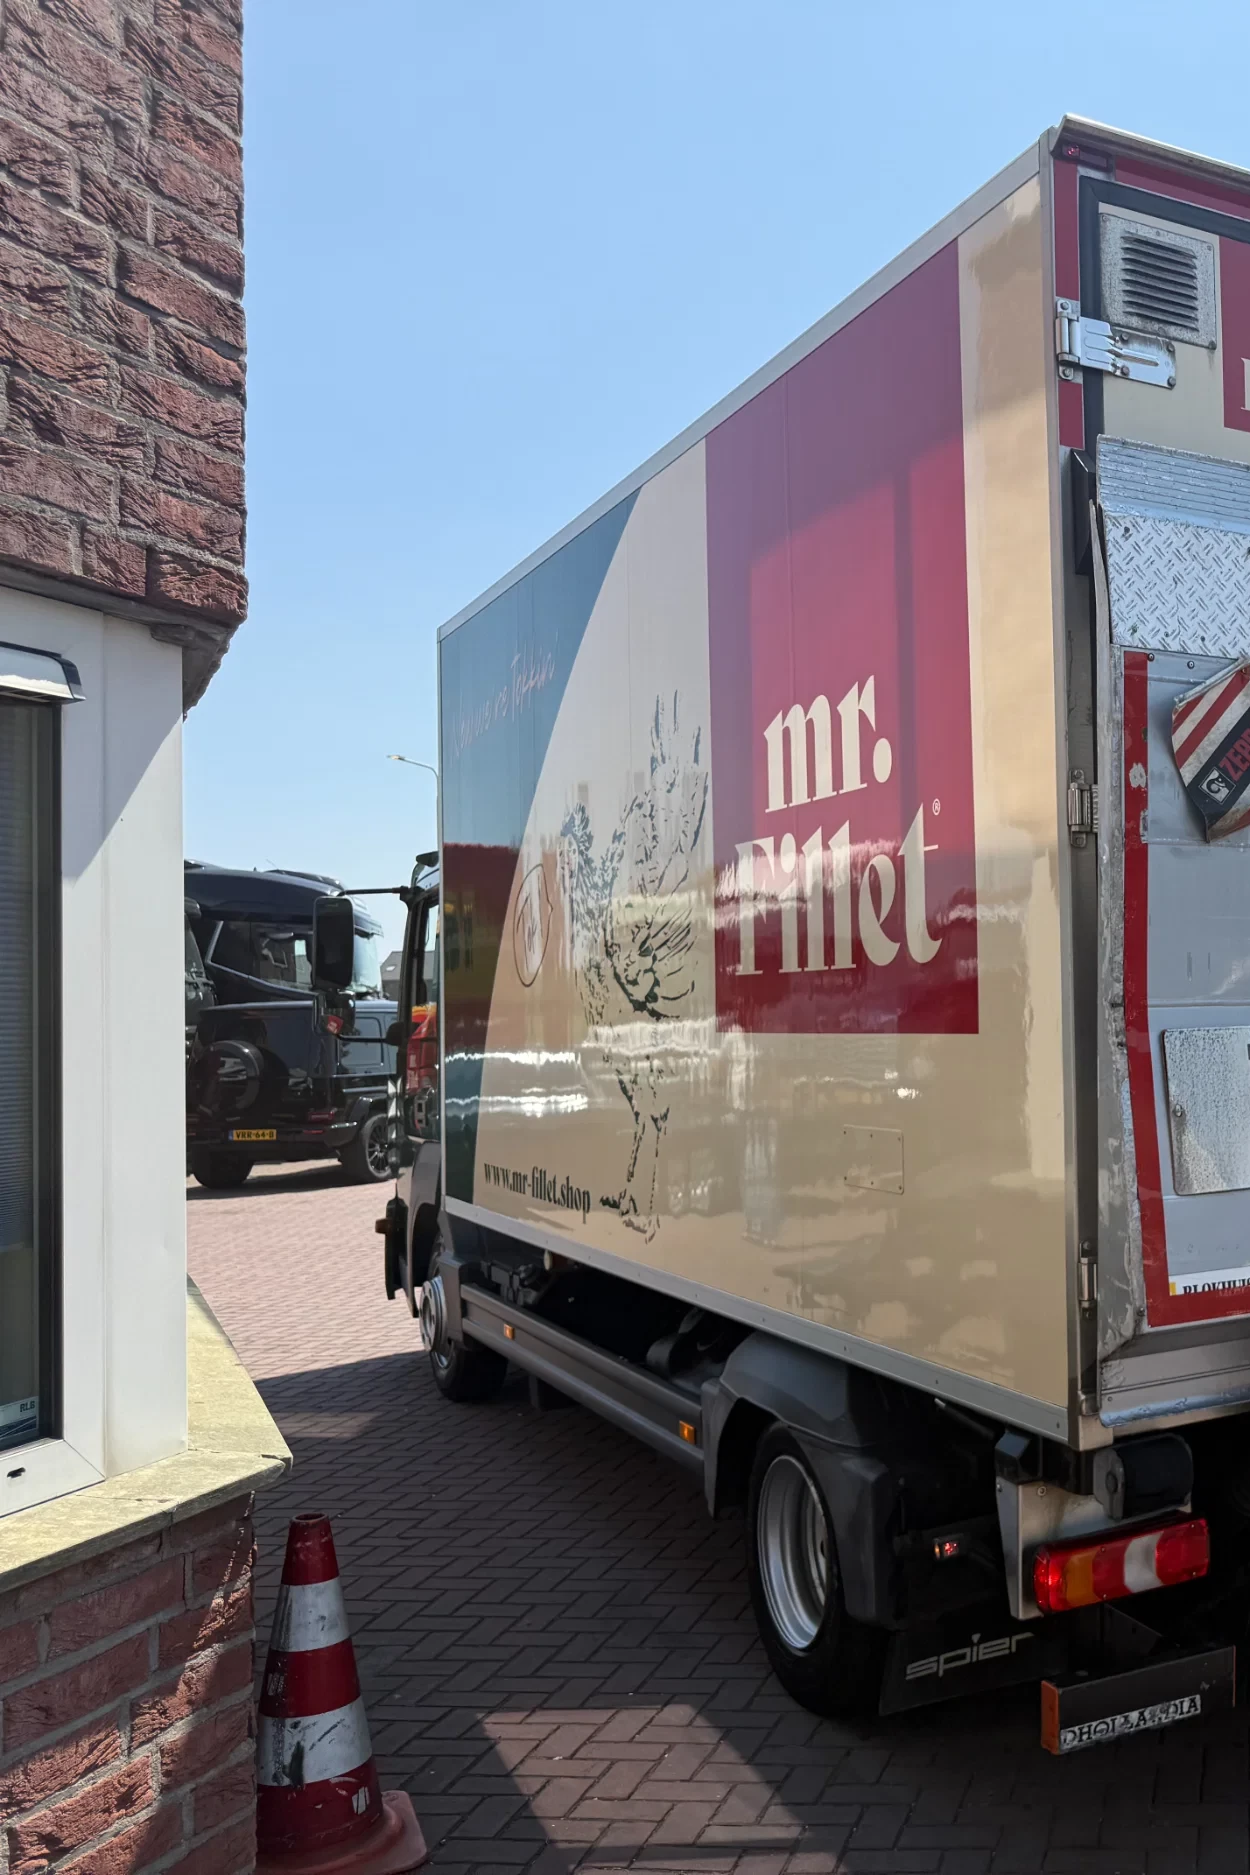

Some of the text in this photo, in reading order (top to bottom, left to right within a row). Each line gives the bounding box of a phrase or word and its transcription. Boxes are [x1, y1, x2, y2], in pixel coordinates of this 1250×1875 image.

[763, 674, 892, 813] mr.
[735, 803, 943, 976] Fillet
[484, 1162, 591, 1225] www.mr-fillet.shop
[904, 1631, 1035, 1681] spier
